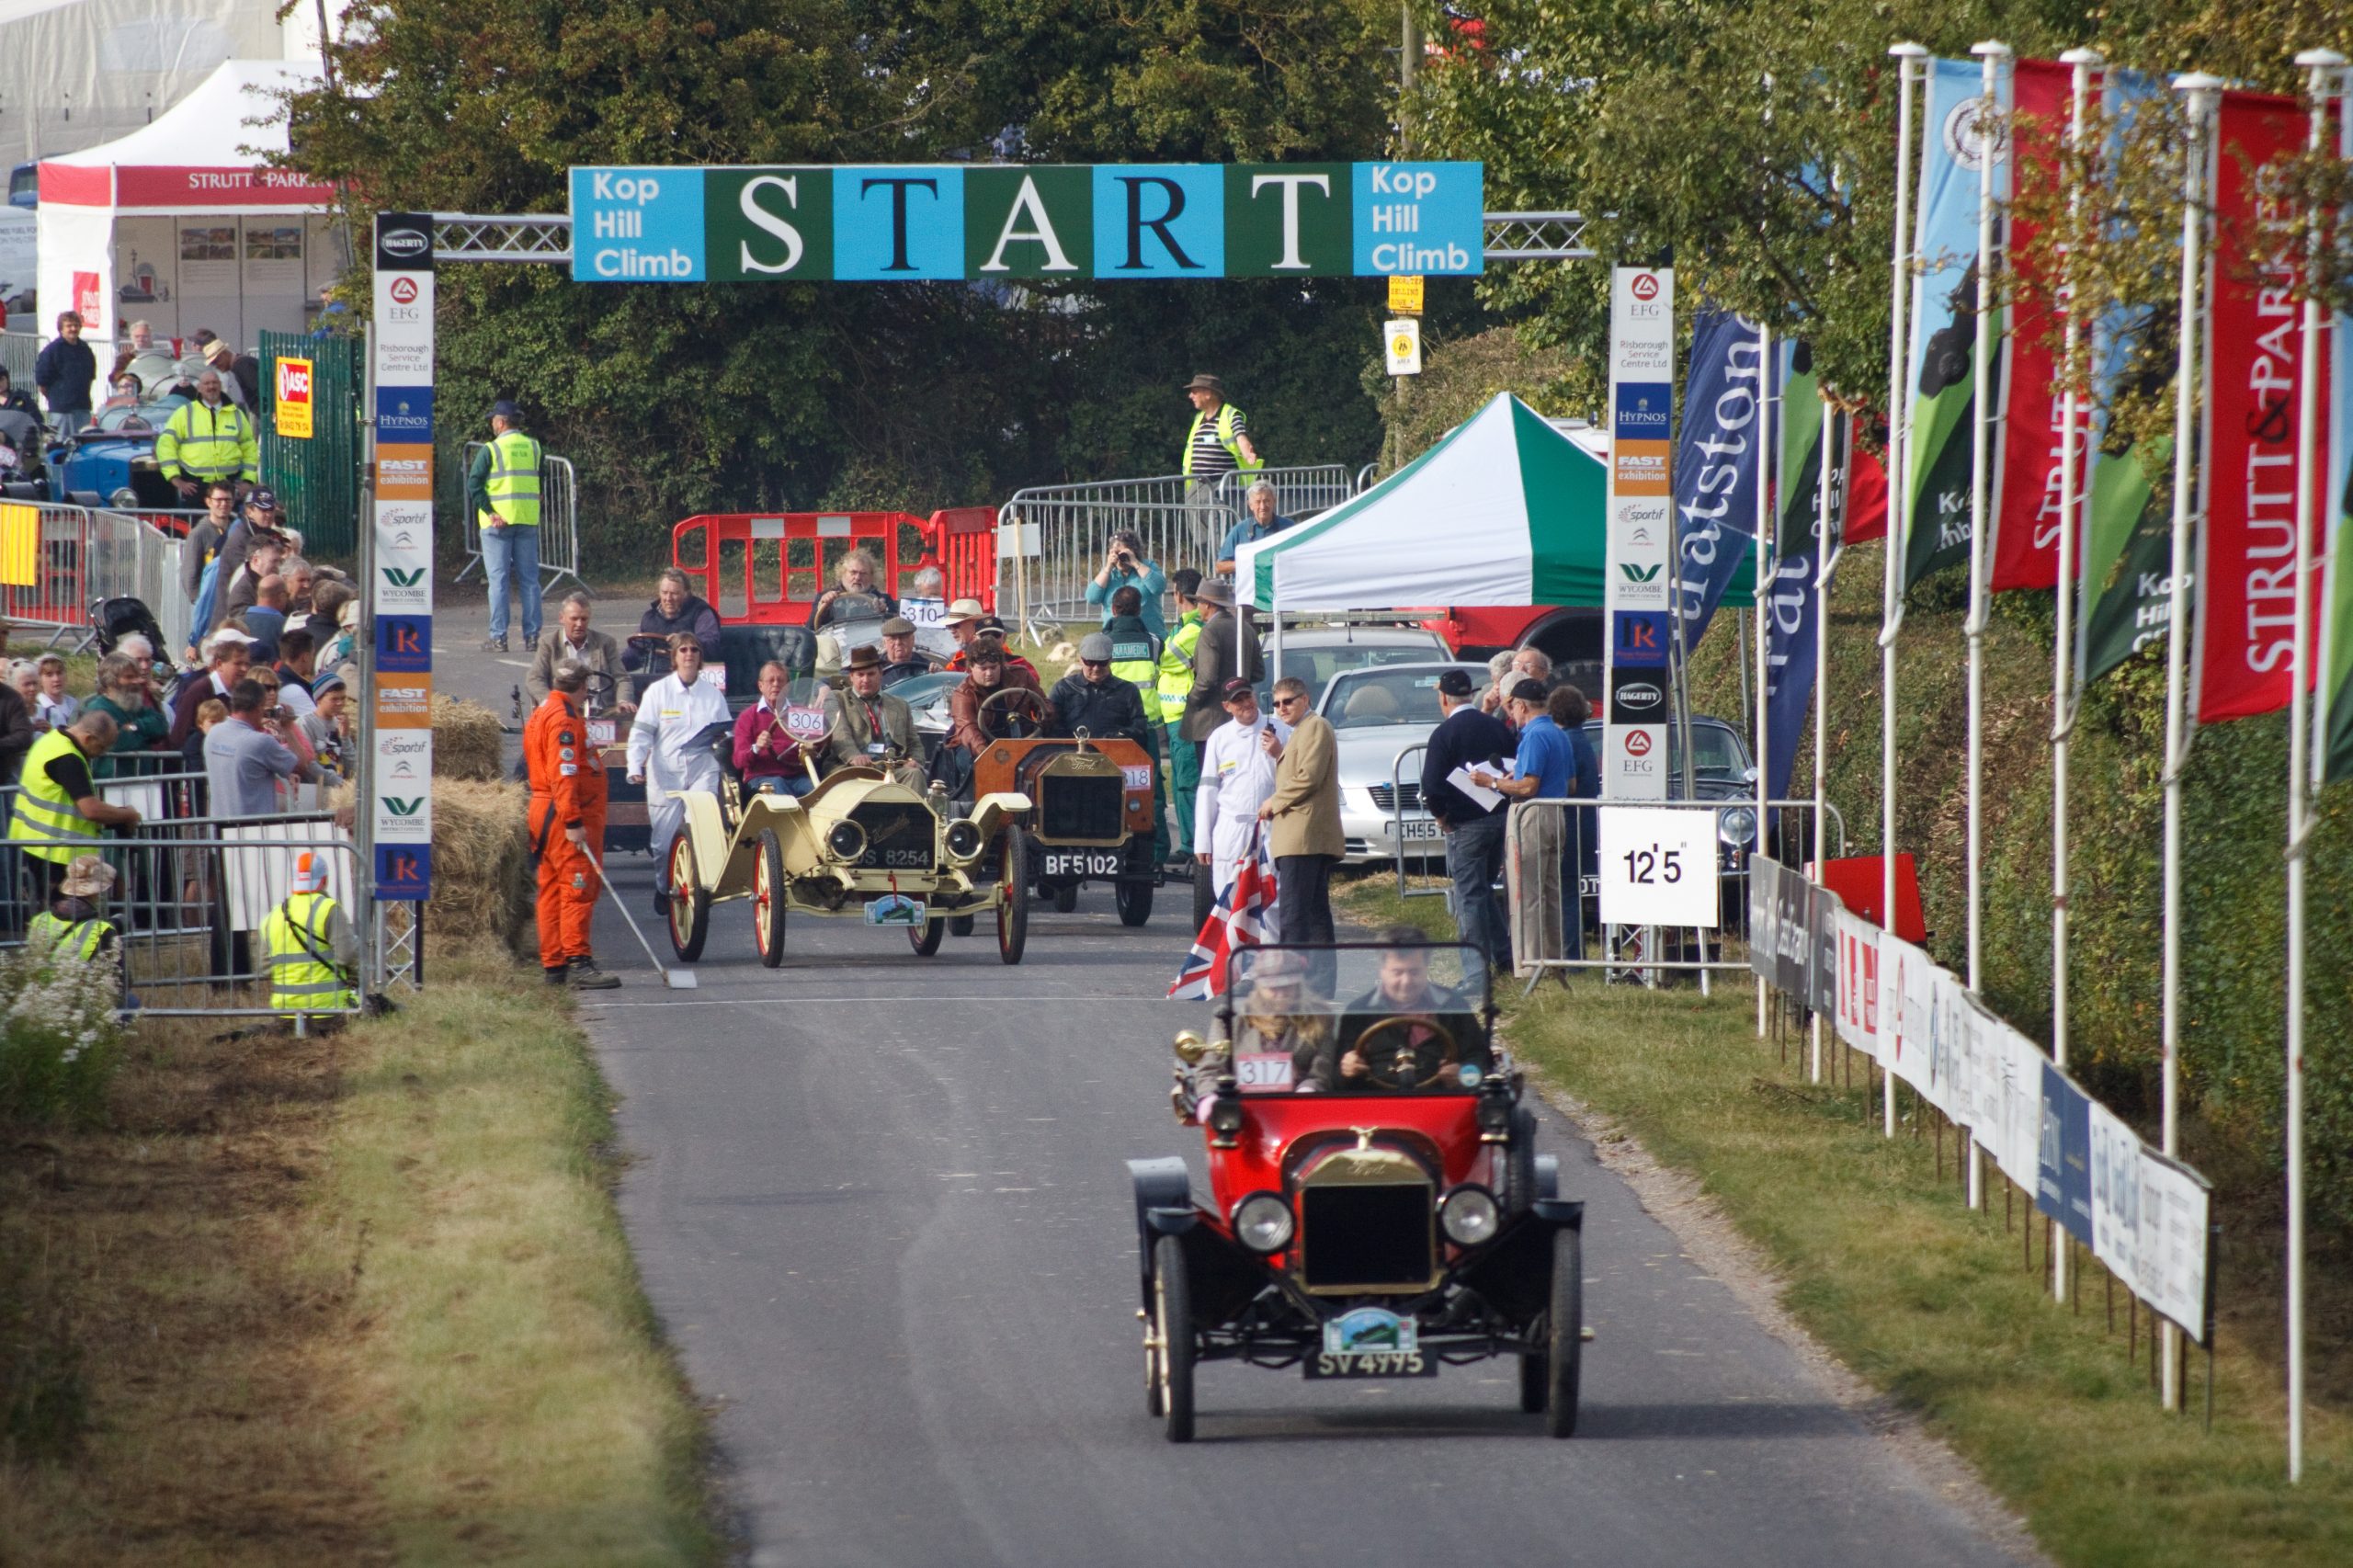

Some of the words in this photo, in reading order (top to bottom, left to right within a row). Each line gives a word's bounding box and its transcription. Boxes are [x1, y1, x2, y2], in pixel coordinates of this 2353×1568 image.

[188, 172, 253, 188] STRUTT
[1372, 166, 1436, 199] Kop
[594, 173, 659, 206] Kop
[594, 210, 642, 238] Hill
[740, 174, 1329, 273] START
[1373, 205, 1418, 232] Hill
[385, 239, 423, 248] HAGERTY
[595, 250, 692, 277] Climb
[1372, 243, 1469, 271] Climb
[390, 307, 419, 320] EFG
[1631, 304, 1659, 317] EFG
[381, 344, 429, 355] Risborough
[1620, 340, 1668, 351] Risborough
[389, 354, 421, 362] Service
[1628, 350, 1660, 358] Service
[381, 363, 411, 371] Centre
[414, 363, 428, 371] Ltd
[1620, 359, 1650, 369] Centre
[1653, 359, 1667, 369] Ltd
[380, 415, 428, 426] HYPNOS
[1619, 412, 1666, 422] HYPNOS
[380, 460, 427, 470] FAST
[1618, 456, 1665, 466] FAST
[381, 475, 428, 485] exhibition
[1618, 471, 1666, 481] exhibition
[392, 513, 427, 526] sportif
[1631, 508, 1665, 521] sportif
[2246, 442, 2296, 673] STRUTT
[906, 607, 938, 622] 310
[2136, 603, 2172, 629] Hil
[380, 688, 426, 698] FAST
[1620, 691, 1658, 700] HAGERTY
[380, 703, 427, 713] exhibition
[790, 713, 821, 730] 306
[392, 741, 427, 755] sportif
[1071, 757, 1095, 771] Ford
[1623, 760, 1653, 772] EFG
[381, 818, 426, 826] WYCOMBE
[885, 849, 929, 866] 8254
[1242, 1062, 1288, 1084] 317
